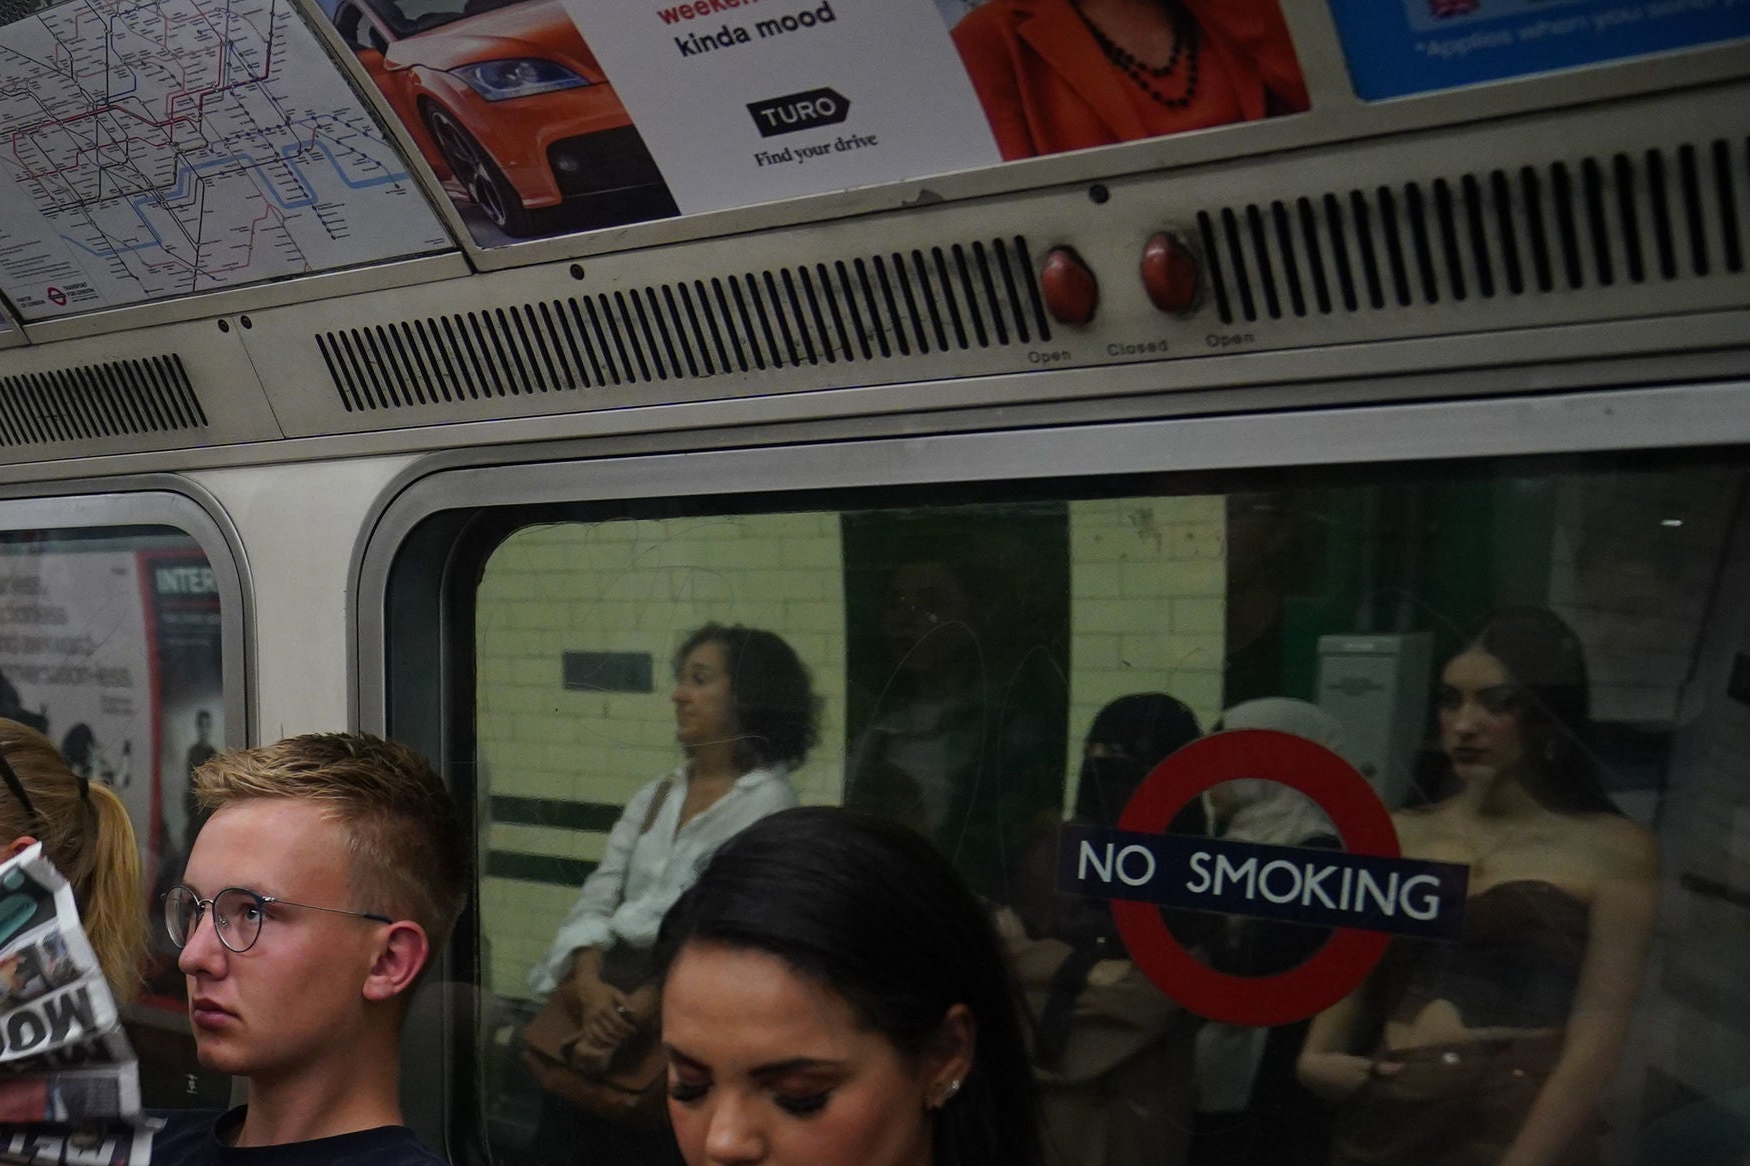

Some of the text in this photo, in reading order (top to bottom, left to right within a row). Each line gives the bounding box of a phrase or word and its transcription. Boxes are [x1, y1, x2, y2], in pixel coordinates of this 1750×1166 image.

[675, 1, 837, 57] kinda mood
[760, 97, 837, 127] TURO
[754, 133, 879, 167] Find your drive
[1028, 333, 1256, 364] Open Closed Open
[1077, 839, 1441, 922] NO SMOKING
